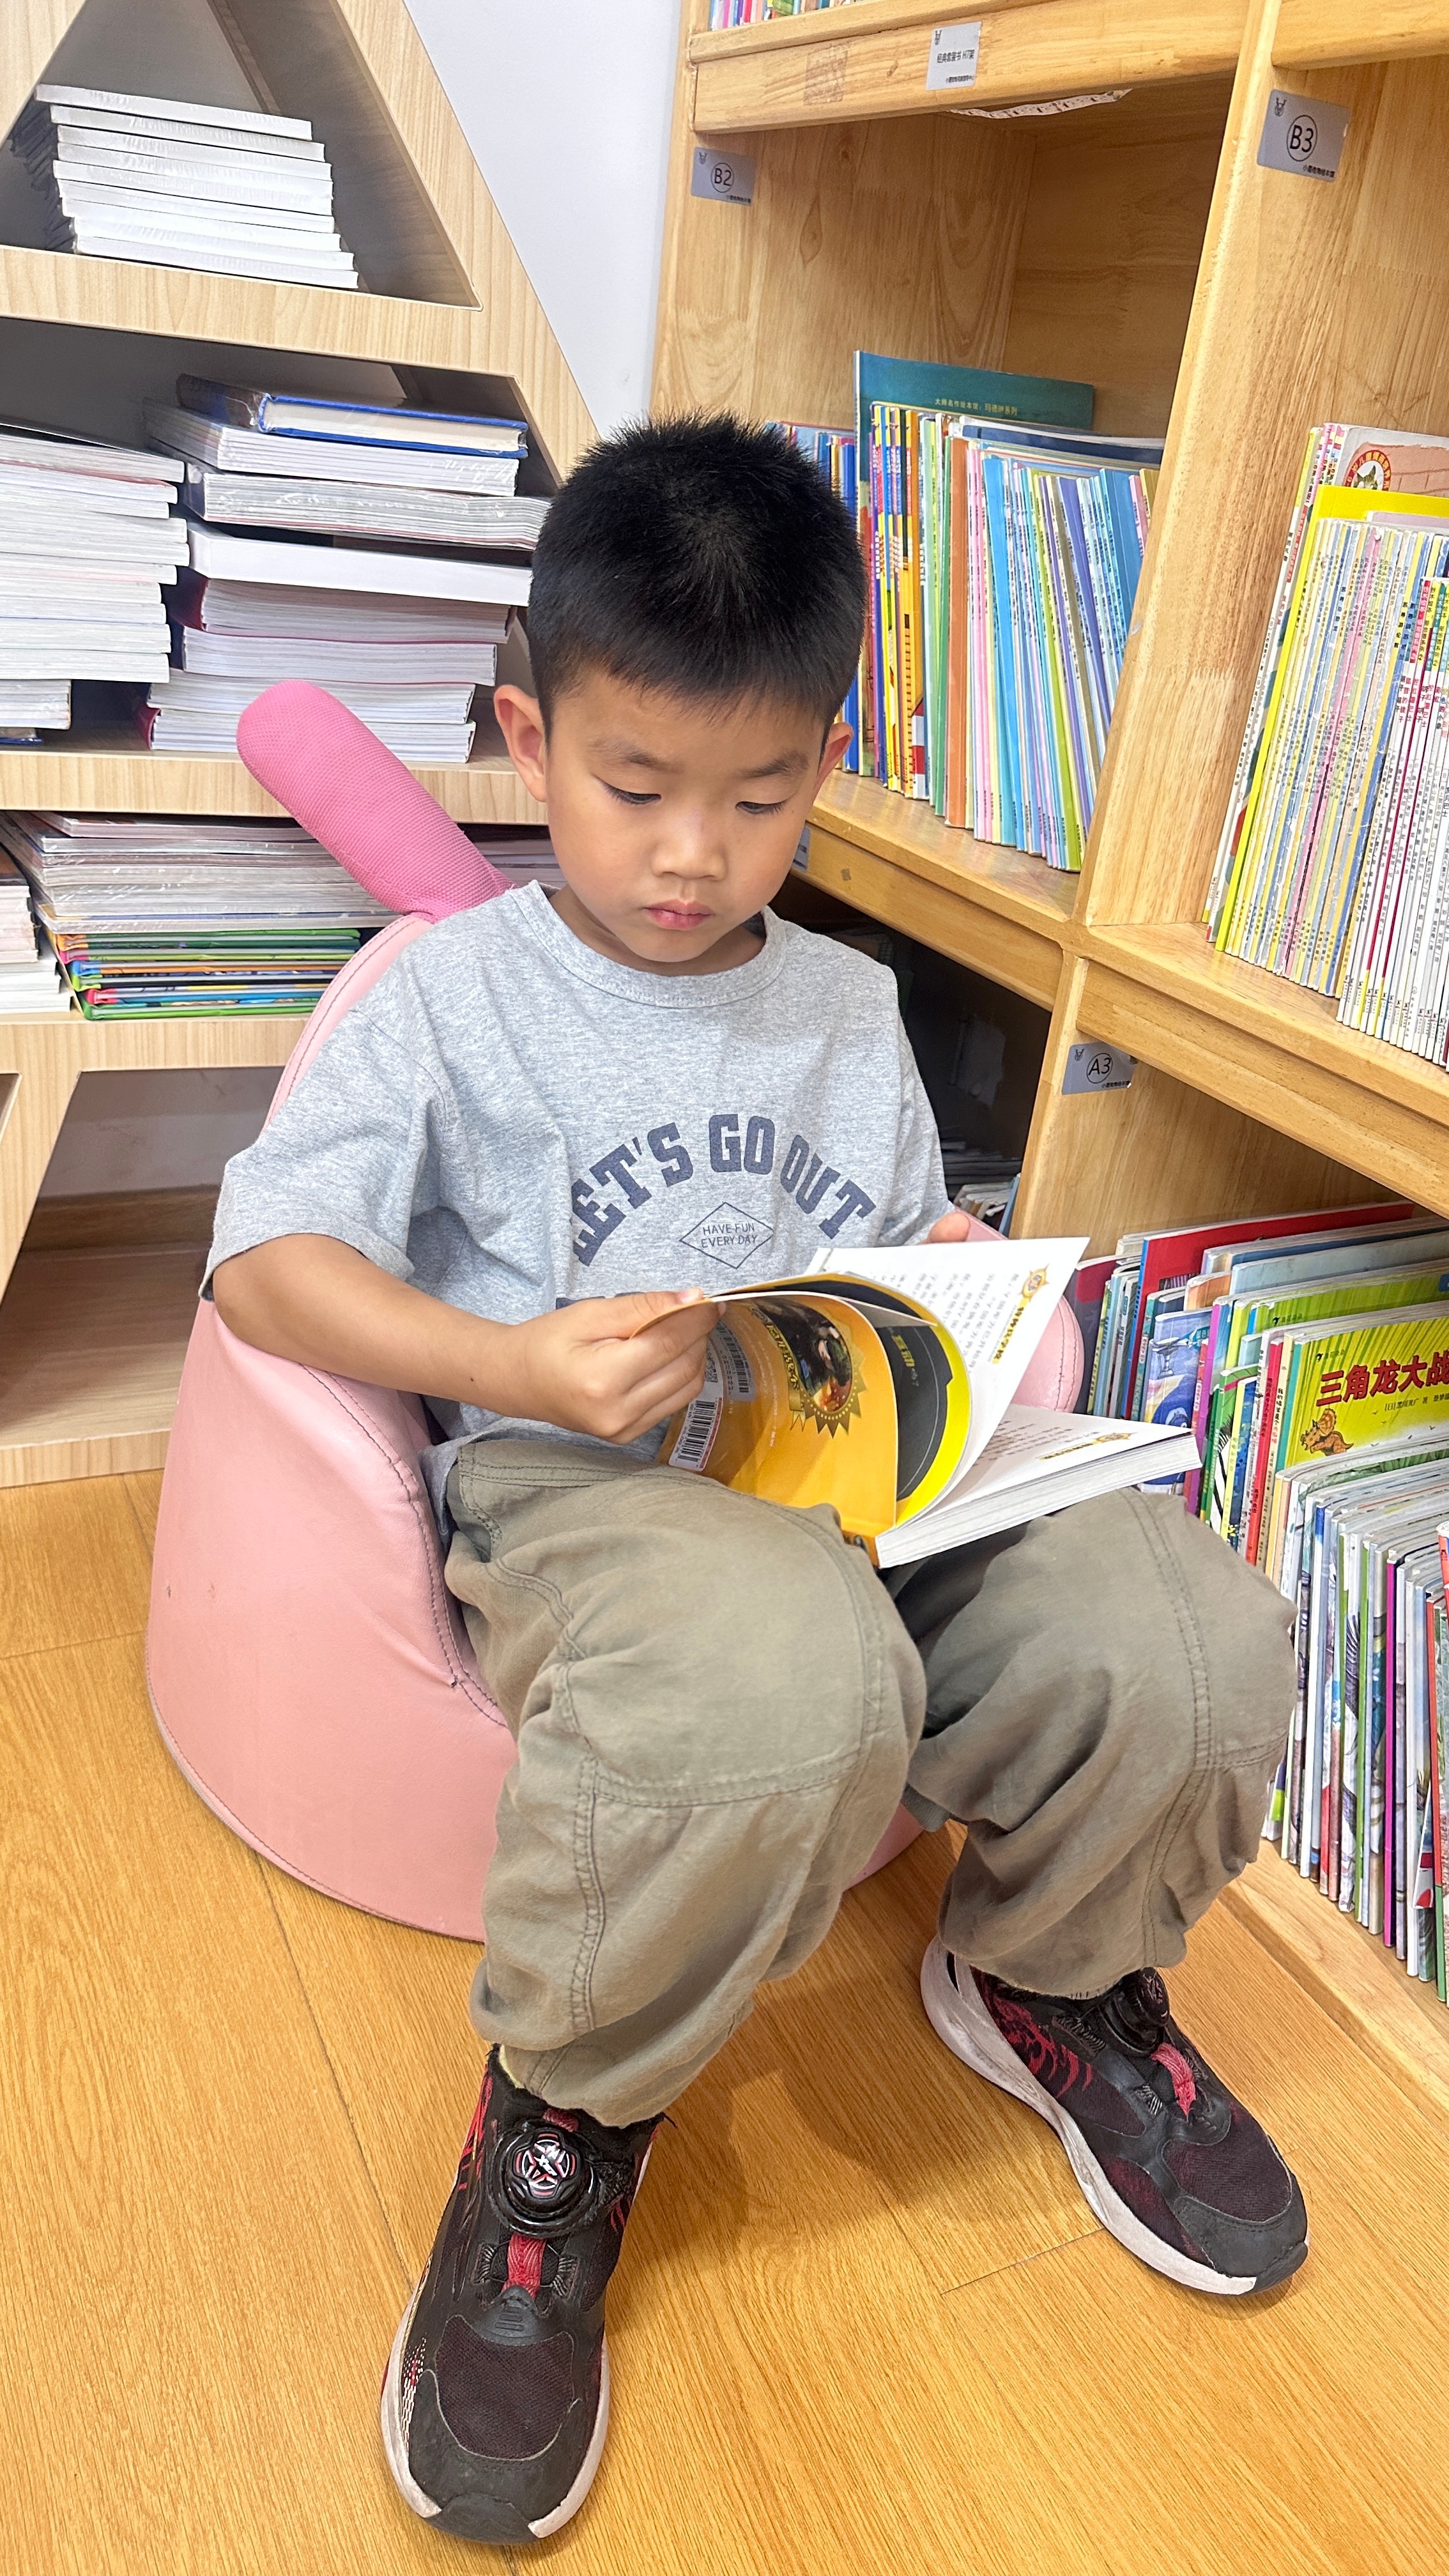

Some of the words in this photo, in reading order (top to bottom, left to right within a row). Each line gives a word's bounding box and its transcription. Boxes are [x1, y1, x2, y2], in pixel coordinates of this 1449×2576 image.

[1290, 125, 1314, 153] B3
[714, 167, 732, 186] B2
[1088, 1057, 1111, 1076] A3
[709, 1114, 775, 1175] GO
[780, 1134, 877, 1240] OUT
[703, 1223, 732, 1235] HAVE
[735, 1223, 755, 1233] FUN
[701, 1235, 735, 1248] EVERY
[738, 1234, 758, 1245] DAY
